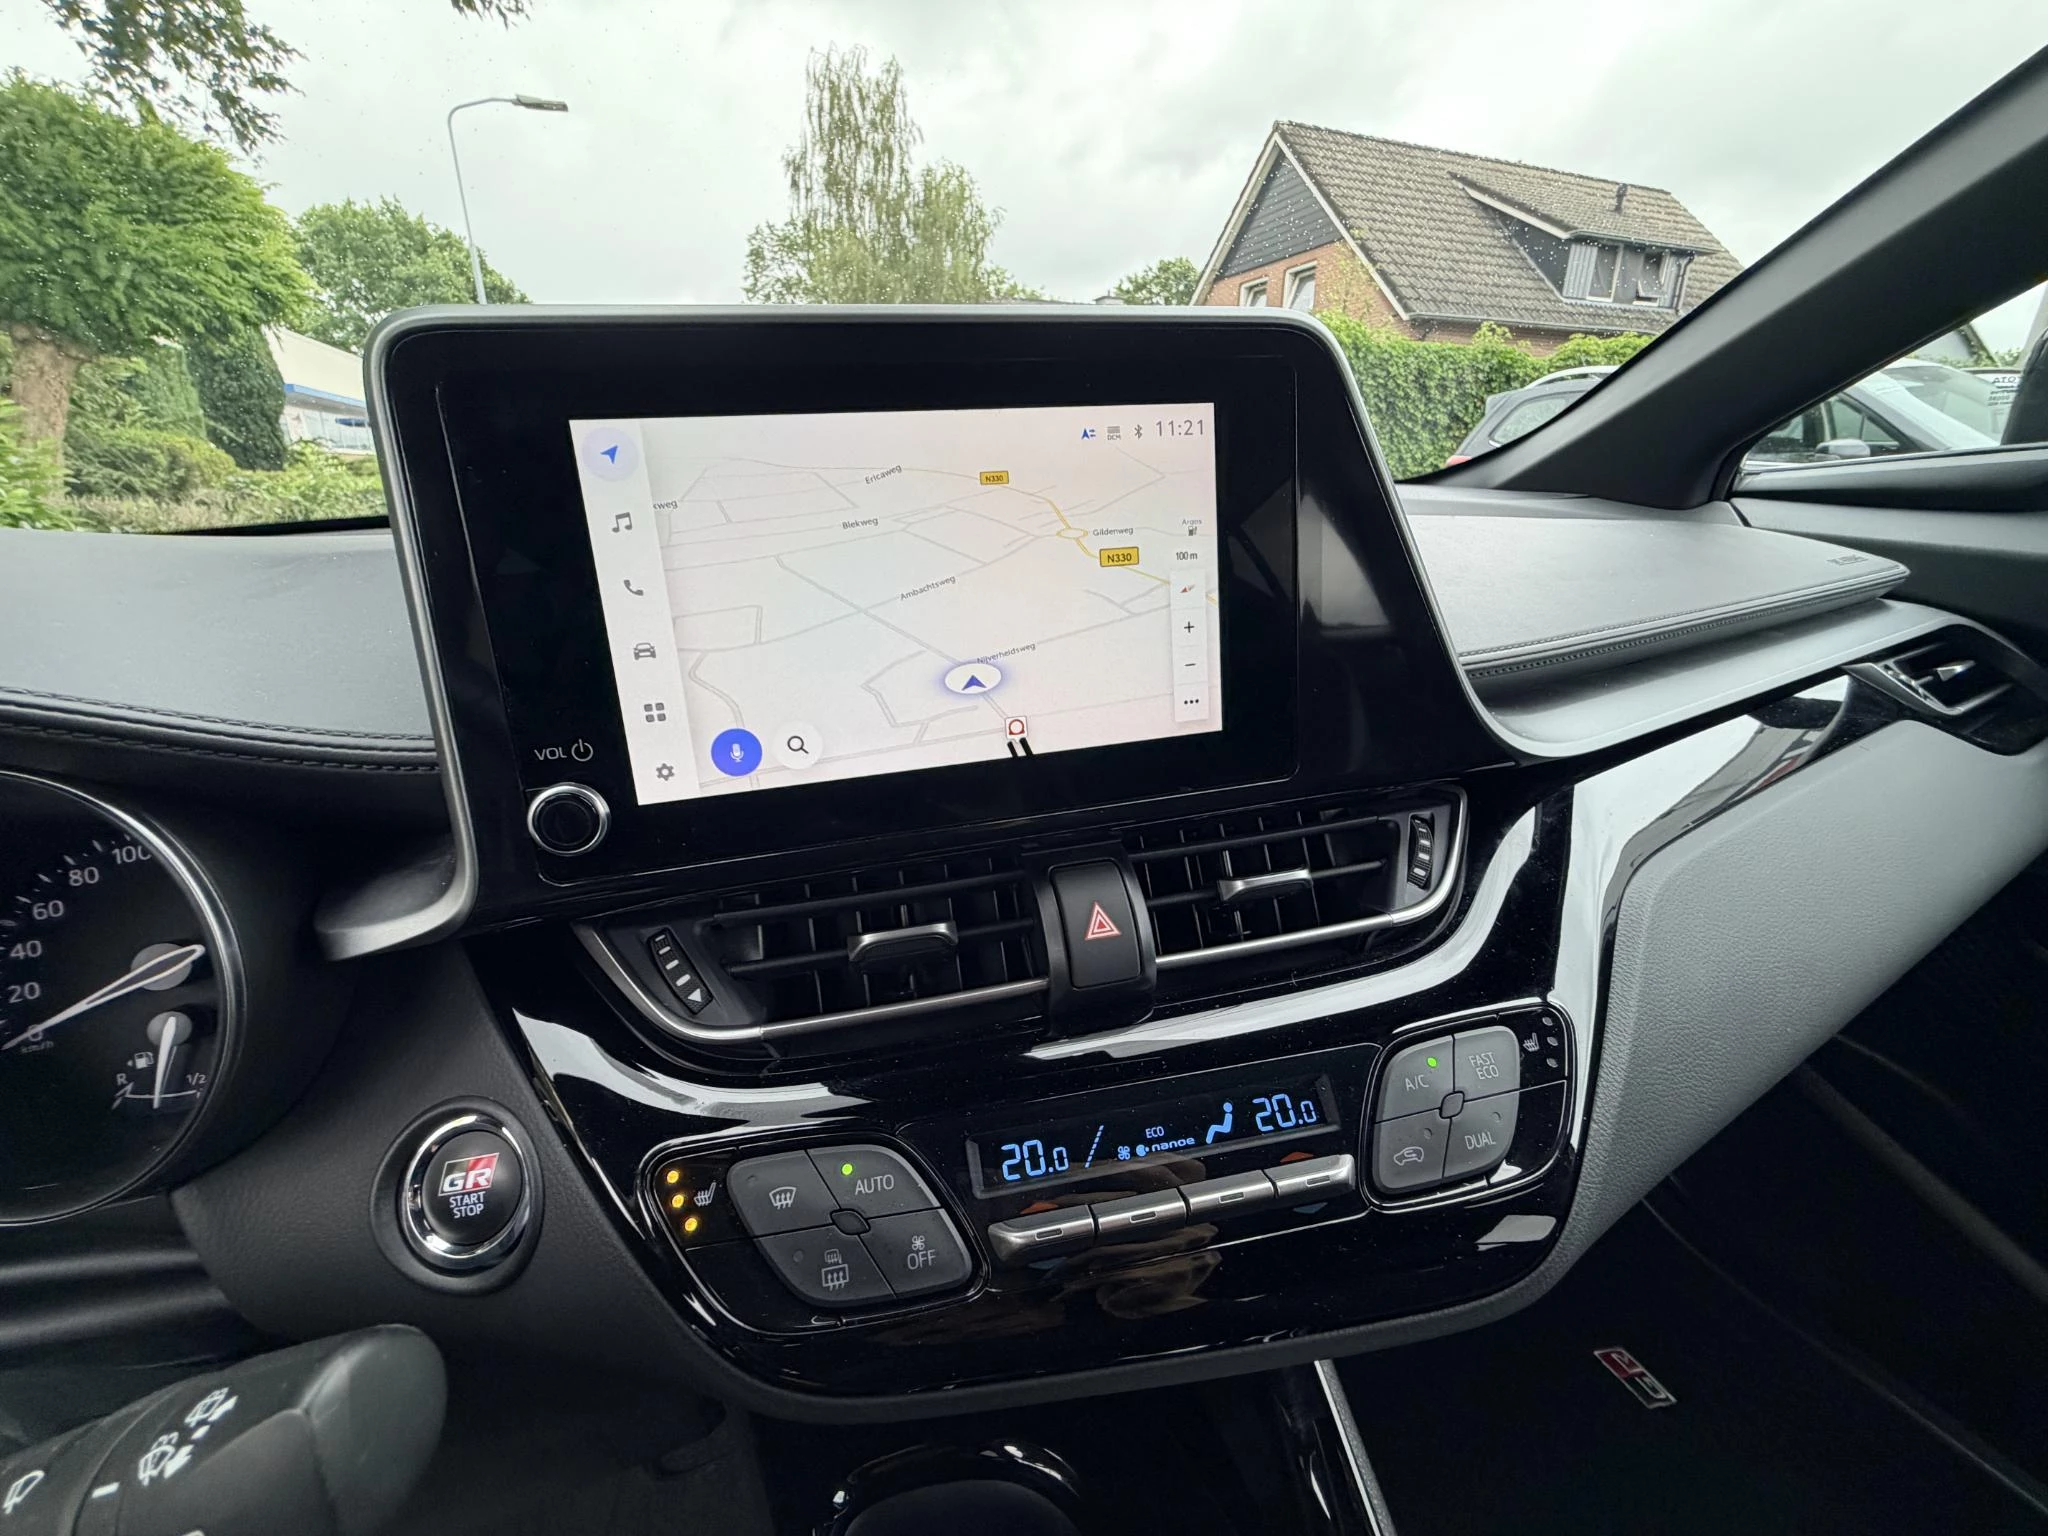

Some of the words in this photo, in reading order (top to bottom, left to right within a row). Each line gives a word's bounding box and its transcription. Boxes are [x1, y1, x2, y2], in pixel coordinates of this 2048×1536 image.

[1155, 419, 1204, 437] 11:21
[865, 464, 902, 484] Ericaweg
[985, 475, 1004, 483] N330
[842, 516, 879, 530] Blekweg
[1093, 526, 1134, 537] Gildenweg
[1107, 552, 1132, 563] N330
[1176, 551, 1189, 560] 100
[1190, 552, 1198, 560] m
[900, 575, 957, 601] Ambachtsweg
[976, 642, 1037, 665] Nijverheidsweg
[534, 747, 567, 761] VOL
[68, 866, 99, 886] 80
[32, 900, 65, 920] 60
[9, 940, 42, 960] 40
[8, 981, 41, 1003] 20
[1469, 1052, 1496, 1067] FAST
[116, 1073, 127, 1085] R
[186, 1073, 206, 1085] 1/2
[1477, 1065, 1499, 1080] ECO
[1405, 1074, 1429, 1091] A/C
[1252, 1093, 1317, 1132] 20.0
[1145, 1126, 1165, 1139] ECO
[1464, 1131, 1497, 1150] DUAL
[1151, 1137, 1196, 1153] nanoe
[1001, 1139, 1070, 1182] 20.0
[442, 1167, 493, 1193] GR
[854, 1174, 895, 1195] AUTO
[449, 1191, 486, 1208] START
[453, 1203, 485, 1219] STOP
[907, 1250, 936, 1270] OFF
